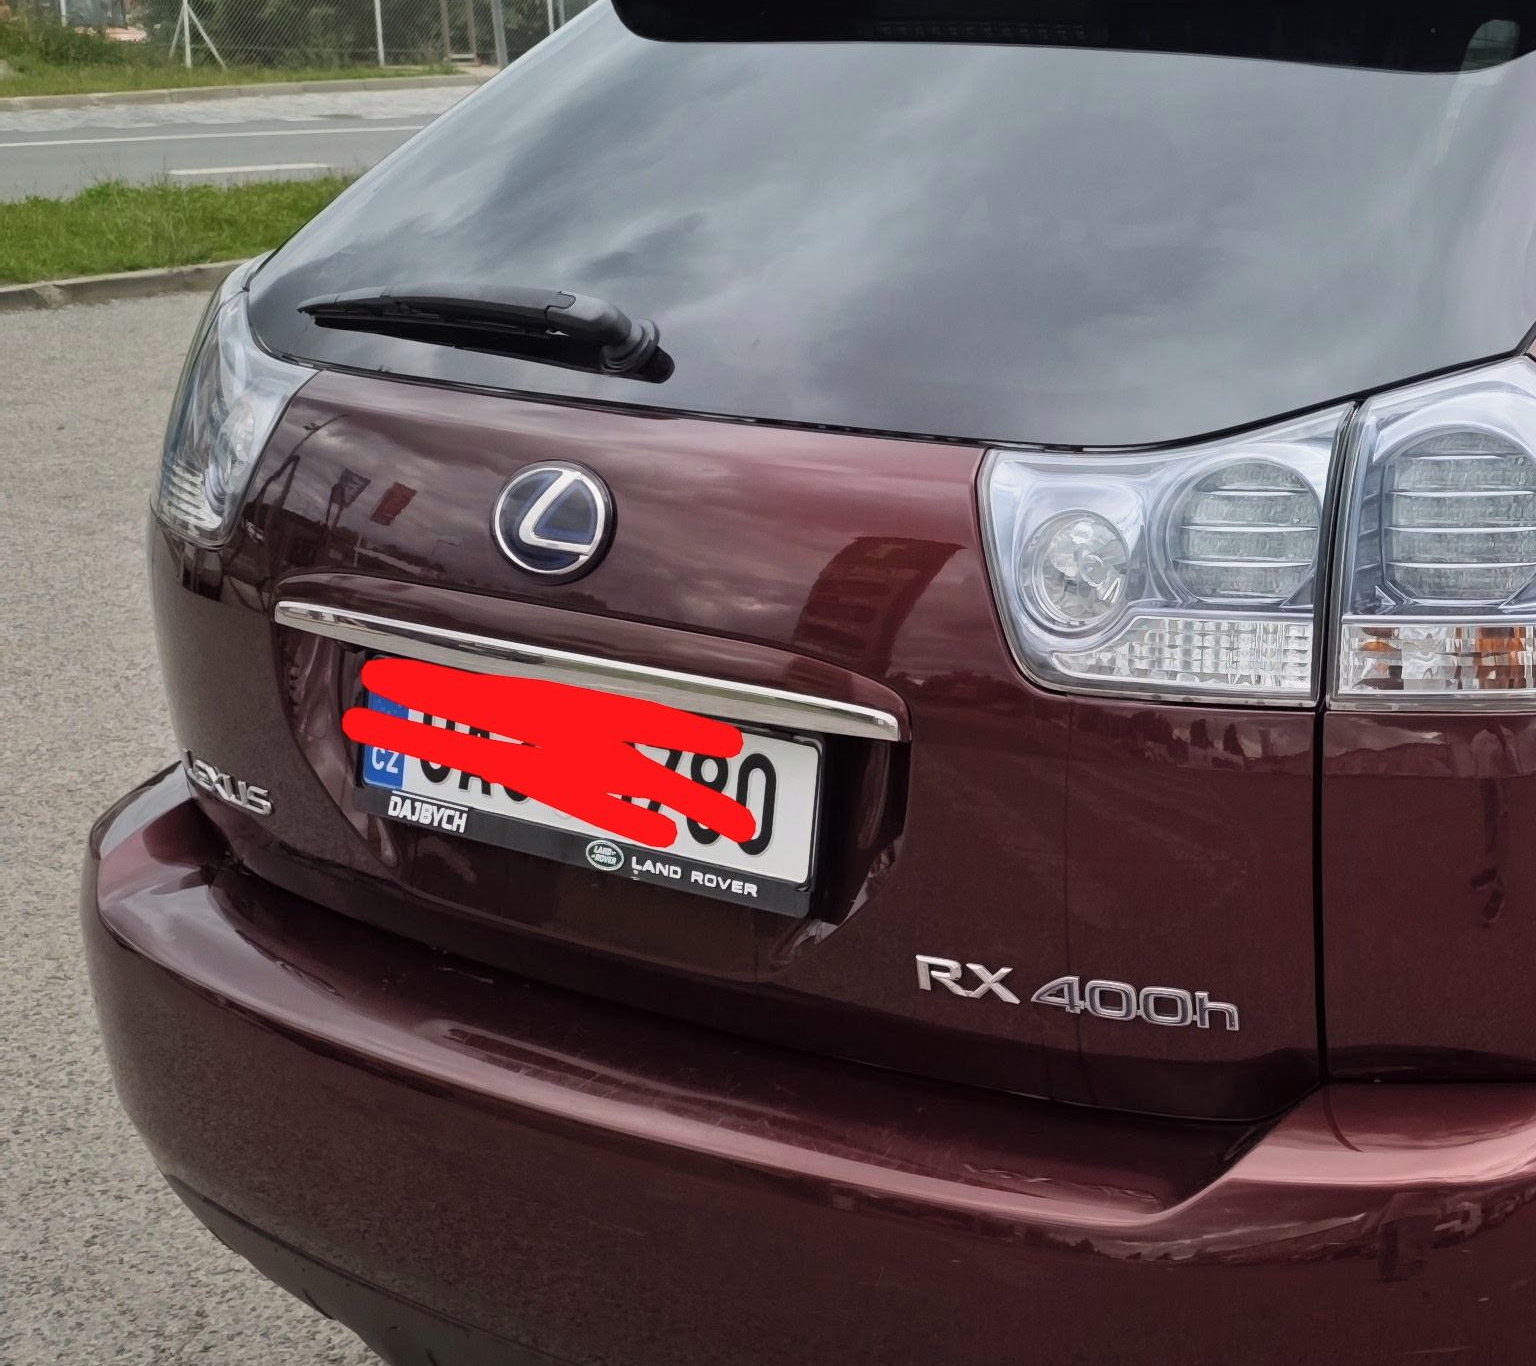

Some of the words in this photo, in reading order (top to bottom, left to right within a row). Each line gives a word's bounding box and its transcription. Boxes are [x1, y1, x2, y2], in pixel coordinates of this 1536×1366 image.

[371, 746, 400, 775] CZ
[387, 795, 468, 835] DAJBYCH
[631, 856, 682, 879] LAND
[690, 869, 758, 898] ROVER
[915, 954, 1021, 1006] RX
[1030, 976, 1240, 1032] 400h
